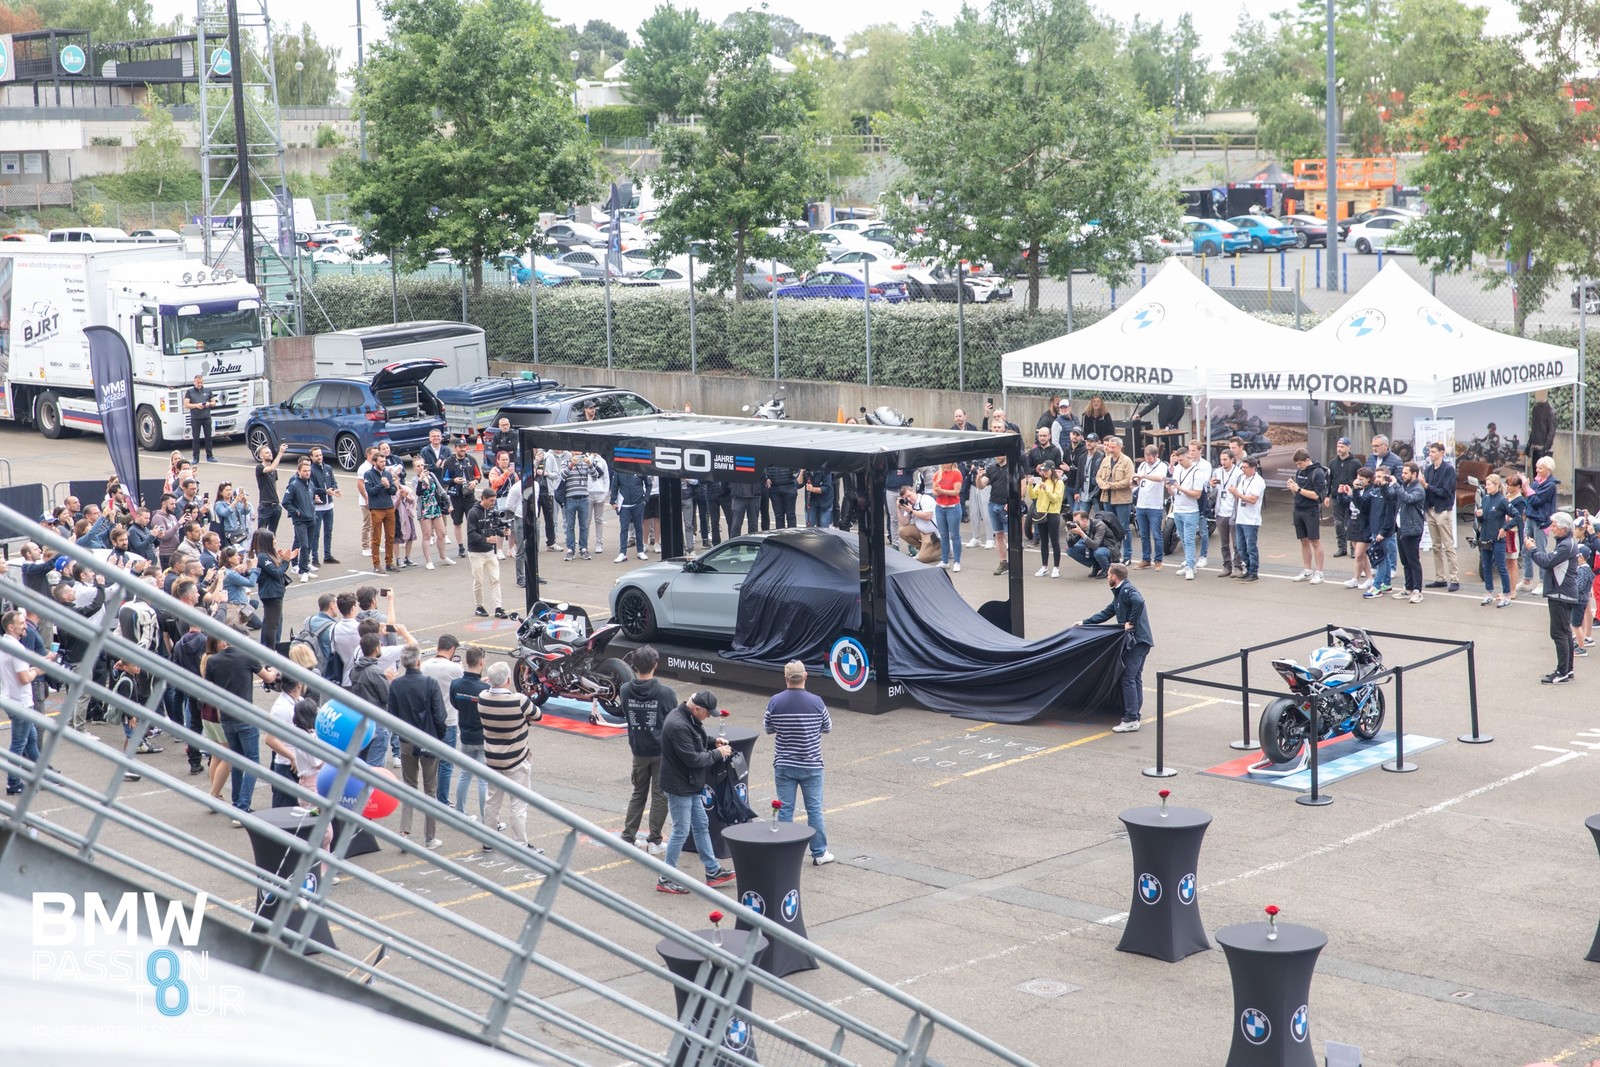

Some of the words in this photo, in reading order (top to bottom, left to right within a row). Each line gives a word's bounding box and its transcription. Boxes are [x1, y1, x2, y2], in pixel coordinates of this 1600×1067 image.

[24, 313, 59, 342] BJRT
[1022, 361, 1066, 379] BMW
[1071, 363, 1174, 385] MOTORRAD
[1452, 371, 1486, 393] BMW
[1490, 360, 1564, 386] MOTORRAD
[1230, 373, 1281, 390] BMW
[1287, 373, 1408, 395] MOTORRAD
[655, 446, 712, 473] 50
[714, 454, 734, 463] JAHRE
[714, 462, 728, 470] BMW
[728, 463, 734, 471] M
[838, 647, 860, 660] BMW
[667, 656, 687, 669] BMW
[687, 660, 700, 671] M4
[700, 662, 716, 674] CSL
[320, 702, 343, 722] MW
